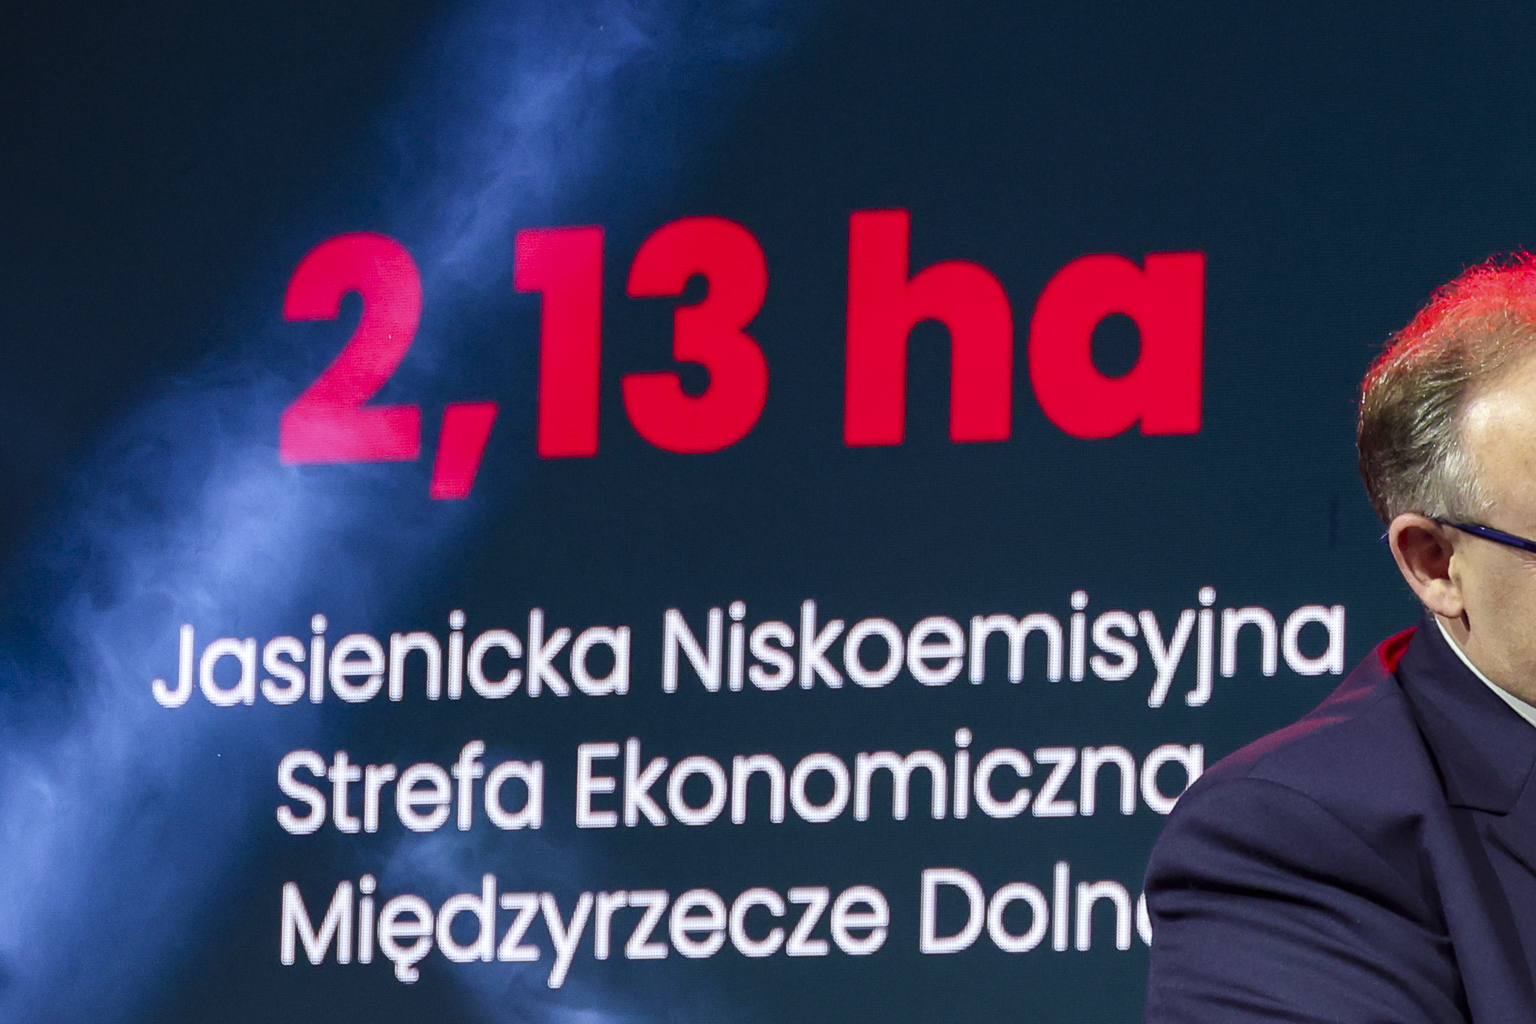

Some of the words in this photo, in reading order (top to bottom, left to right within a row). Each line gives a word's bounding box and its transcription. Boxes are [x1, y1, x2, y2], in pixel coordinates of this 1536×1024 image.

[279, 214, 769, 500] 2,13
[843, 208, 1206, 447] ha
[151, 607, 632, 709] Jasienicka
[662, 585, 1346, 709] Niskoemisyjna
[275, 740, 544, 836] Strefa
[574, 727, 1205, 830] Ekonomiczna
[279, 872, 891, 990] Międzyrzecze
[918, 861, 1154, 955] Doln
